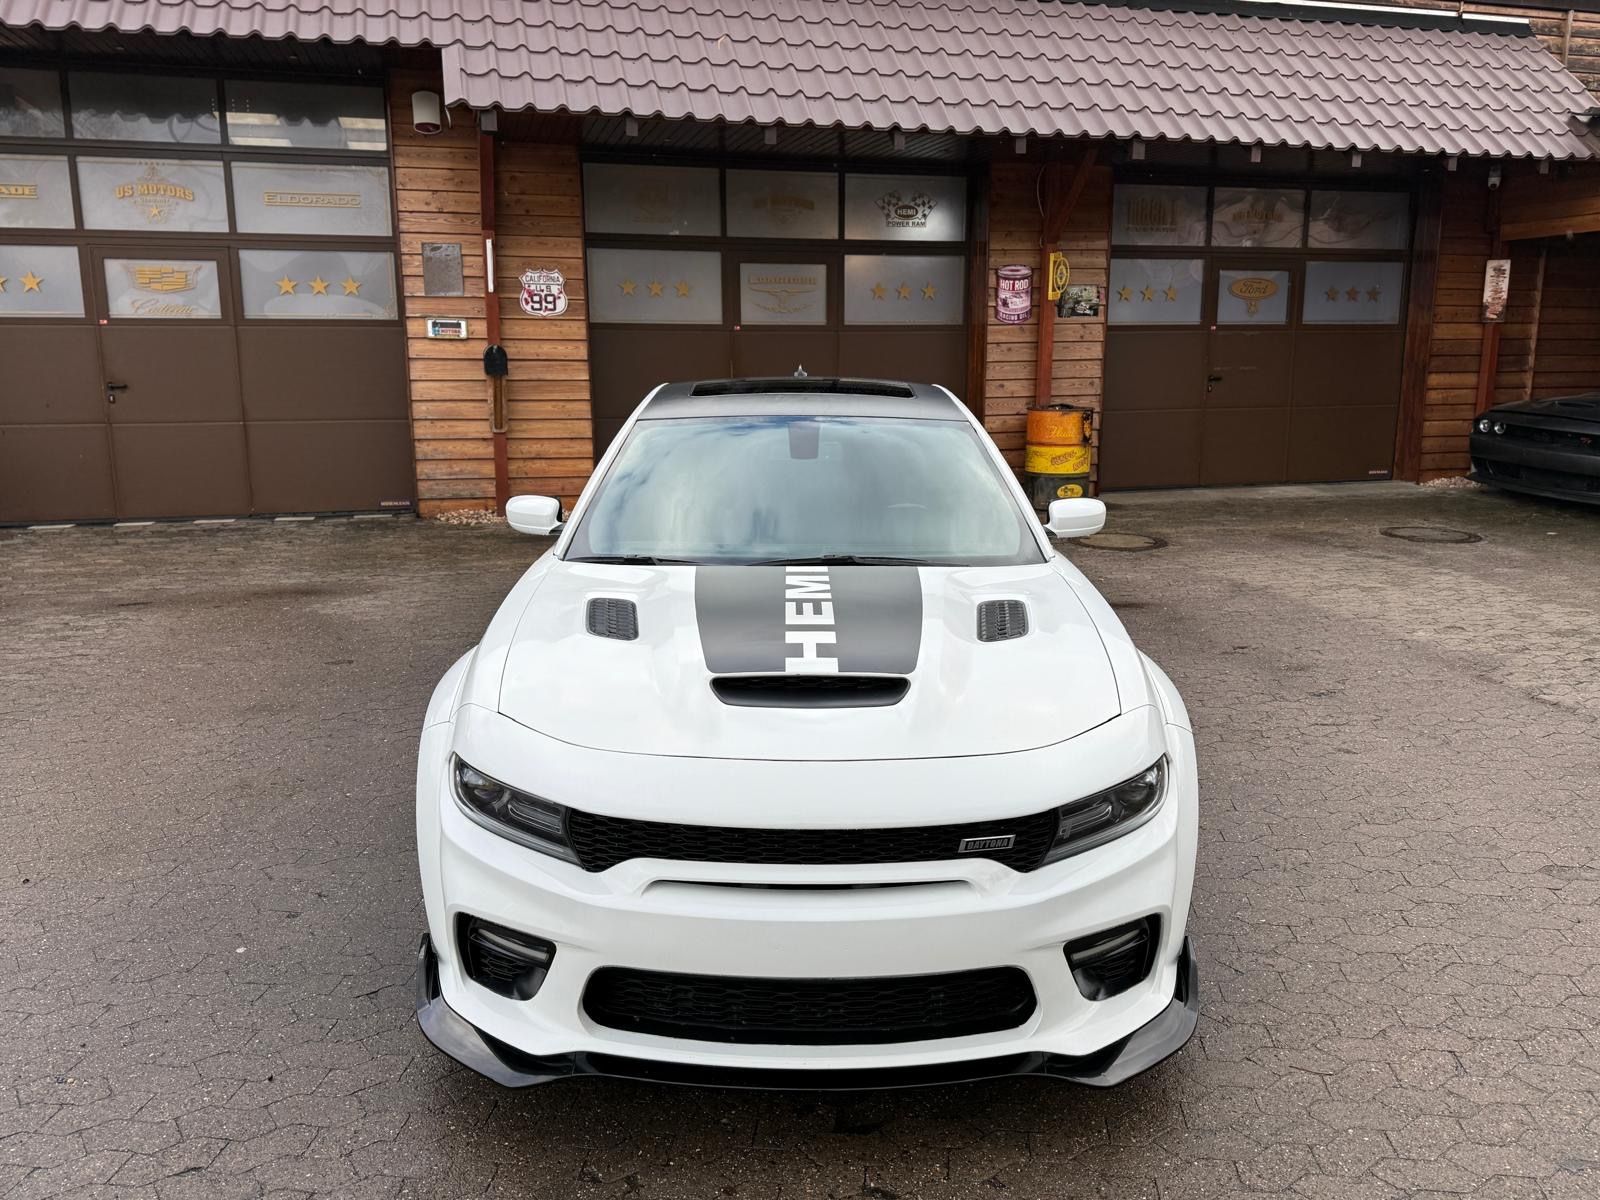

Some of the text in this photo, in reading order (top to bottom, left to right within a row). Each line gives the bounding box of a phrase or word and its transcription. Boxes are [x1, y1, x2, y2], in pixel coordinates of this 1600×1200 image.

[115, 184, 194, 201] US MOTORS
[264, 193, 361, 206] ELDORADO
[897, 207, 917, 217] HEMI
[524, 274, 561, 283] CALIFORNIA
[999, 278, 1029, 291] HOT ROD
[530, 293, 557, 312] 99
[785, 566, 839, 673] HEMI
[967, 838, 1009, 850] DAYTONA
